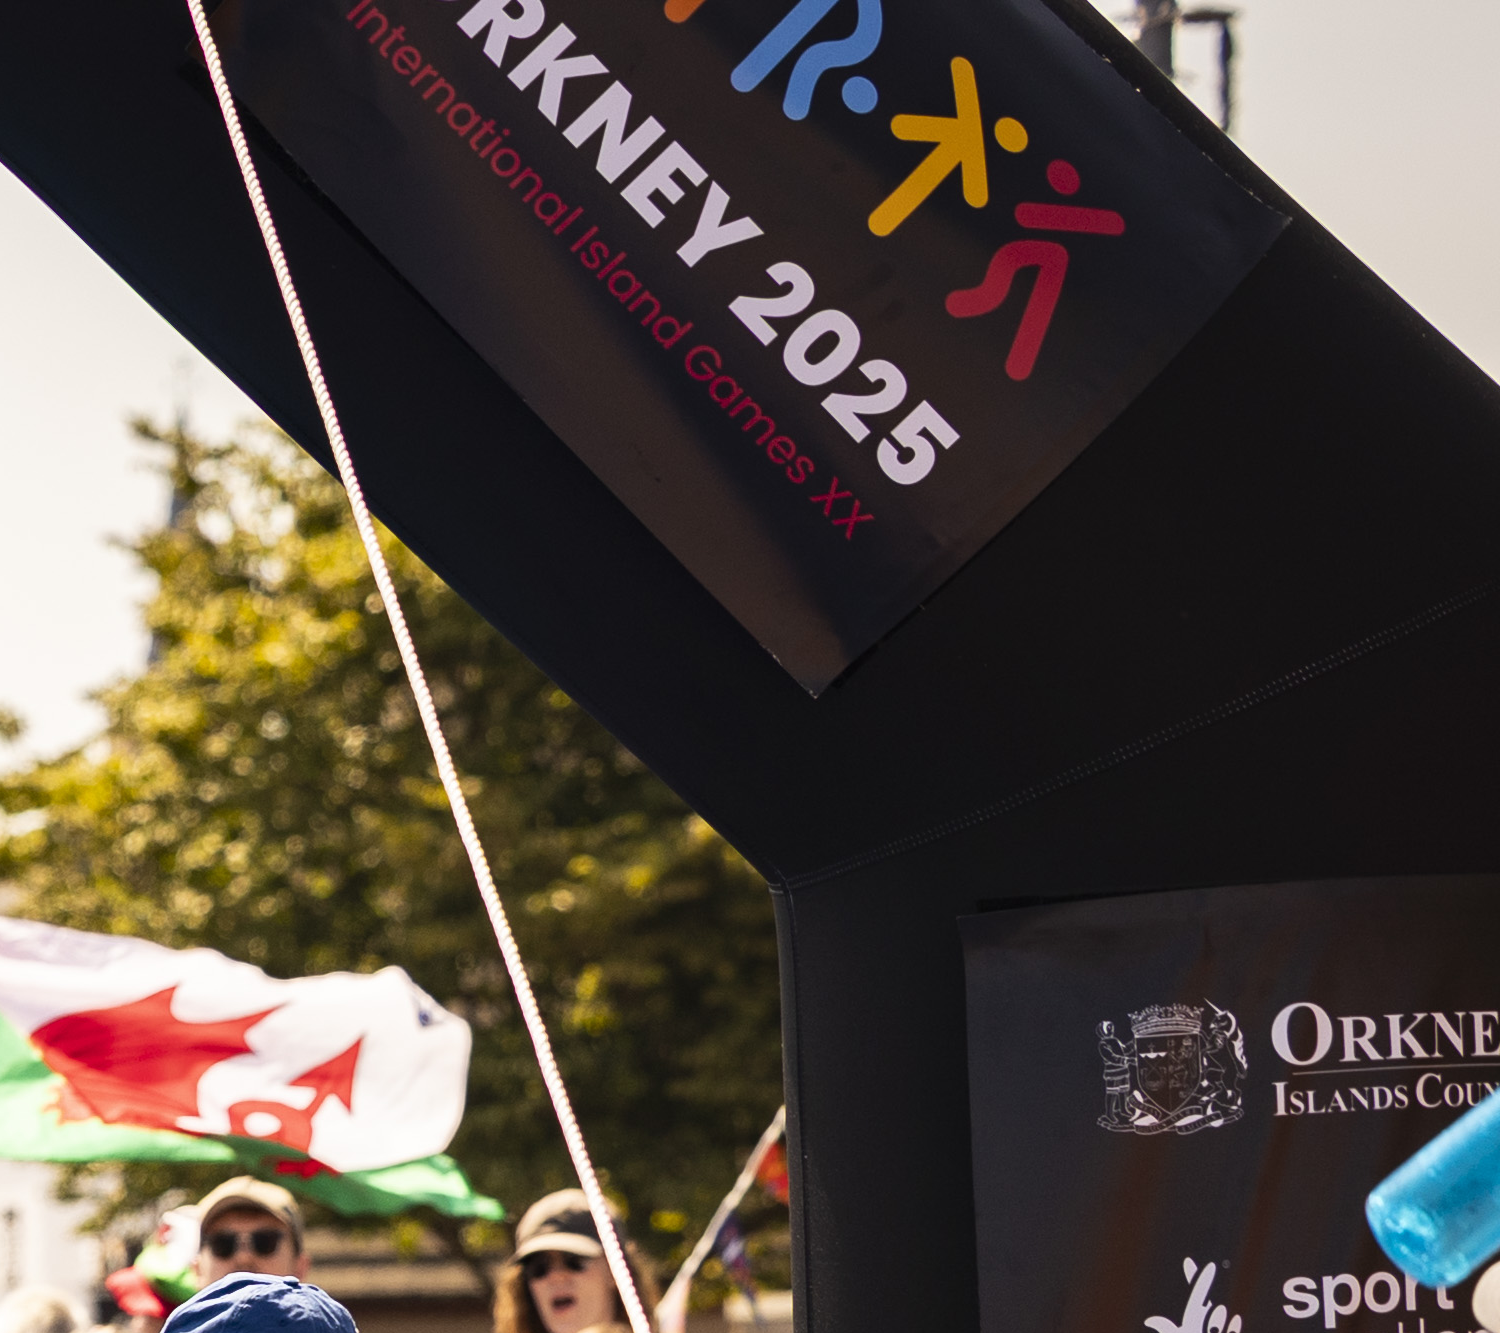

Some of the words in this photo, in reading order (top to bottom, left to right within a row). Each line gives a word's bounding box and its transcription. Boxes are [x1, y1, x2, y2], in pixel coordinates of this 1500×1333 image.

[345, 0, 584, 236] International
[570, 225, 694, 349] Island
[684, 345, 815, 484] Games
[809, 476, 875, 540] XX
[450, 0, 765, 268] RKNEY
[728, 262, 960, 485] 2025
[1272, 1081, 1410, 1116] ISLANDS
